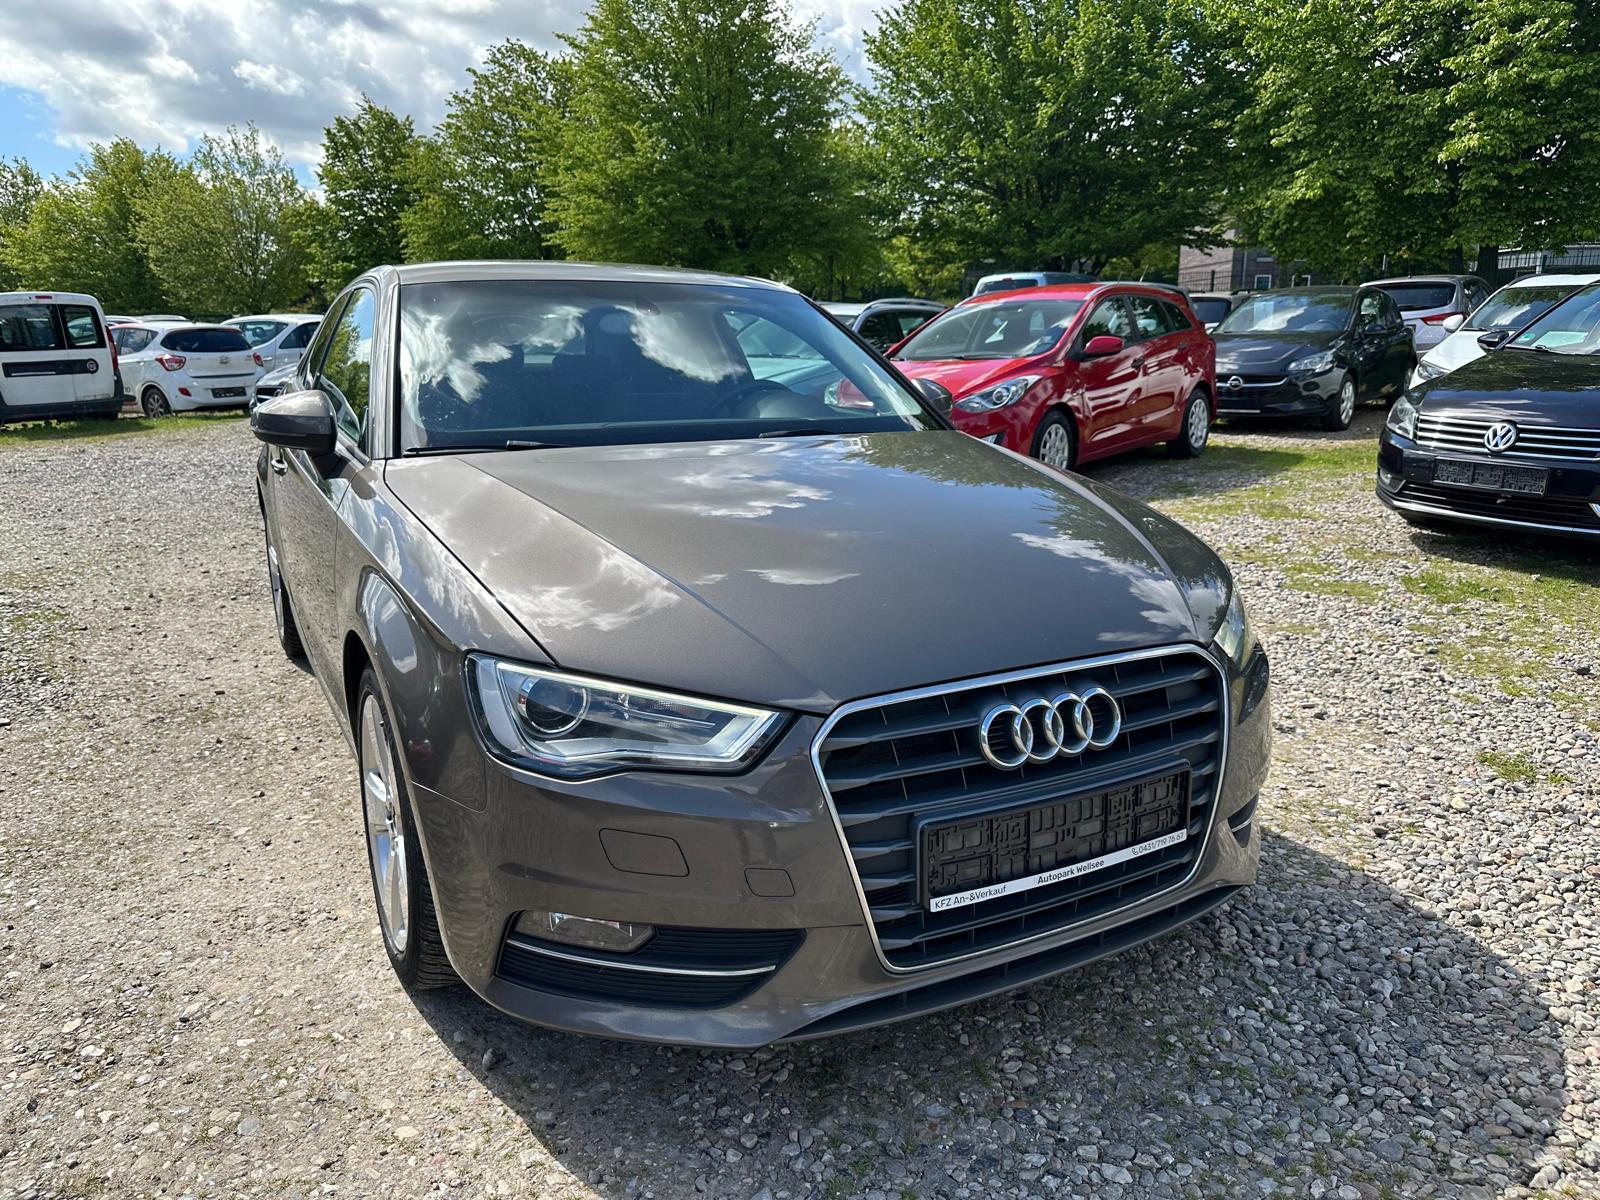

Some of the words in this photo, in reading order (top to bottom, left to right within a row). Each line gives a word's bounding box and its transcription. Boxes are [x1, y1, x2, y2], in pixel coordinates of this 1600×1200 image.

[1138, 838, 1167, 854] 0431/719
[1038, 868, 1075, 884] Autopark
[1076, 859, 1105, 874] Wellsee
[935, 897, 951, 909] KFZ
[954, 885, 1007, 905] An-&Verkauf
